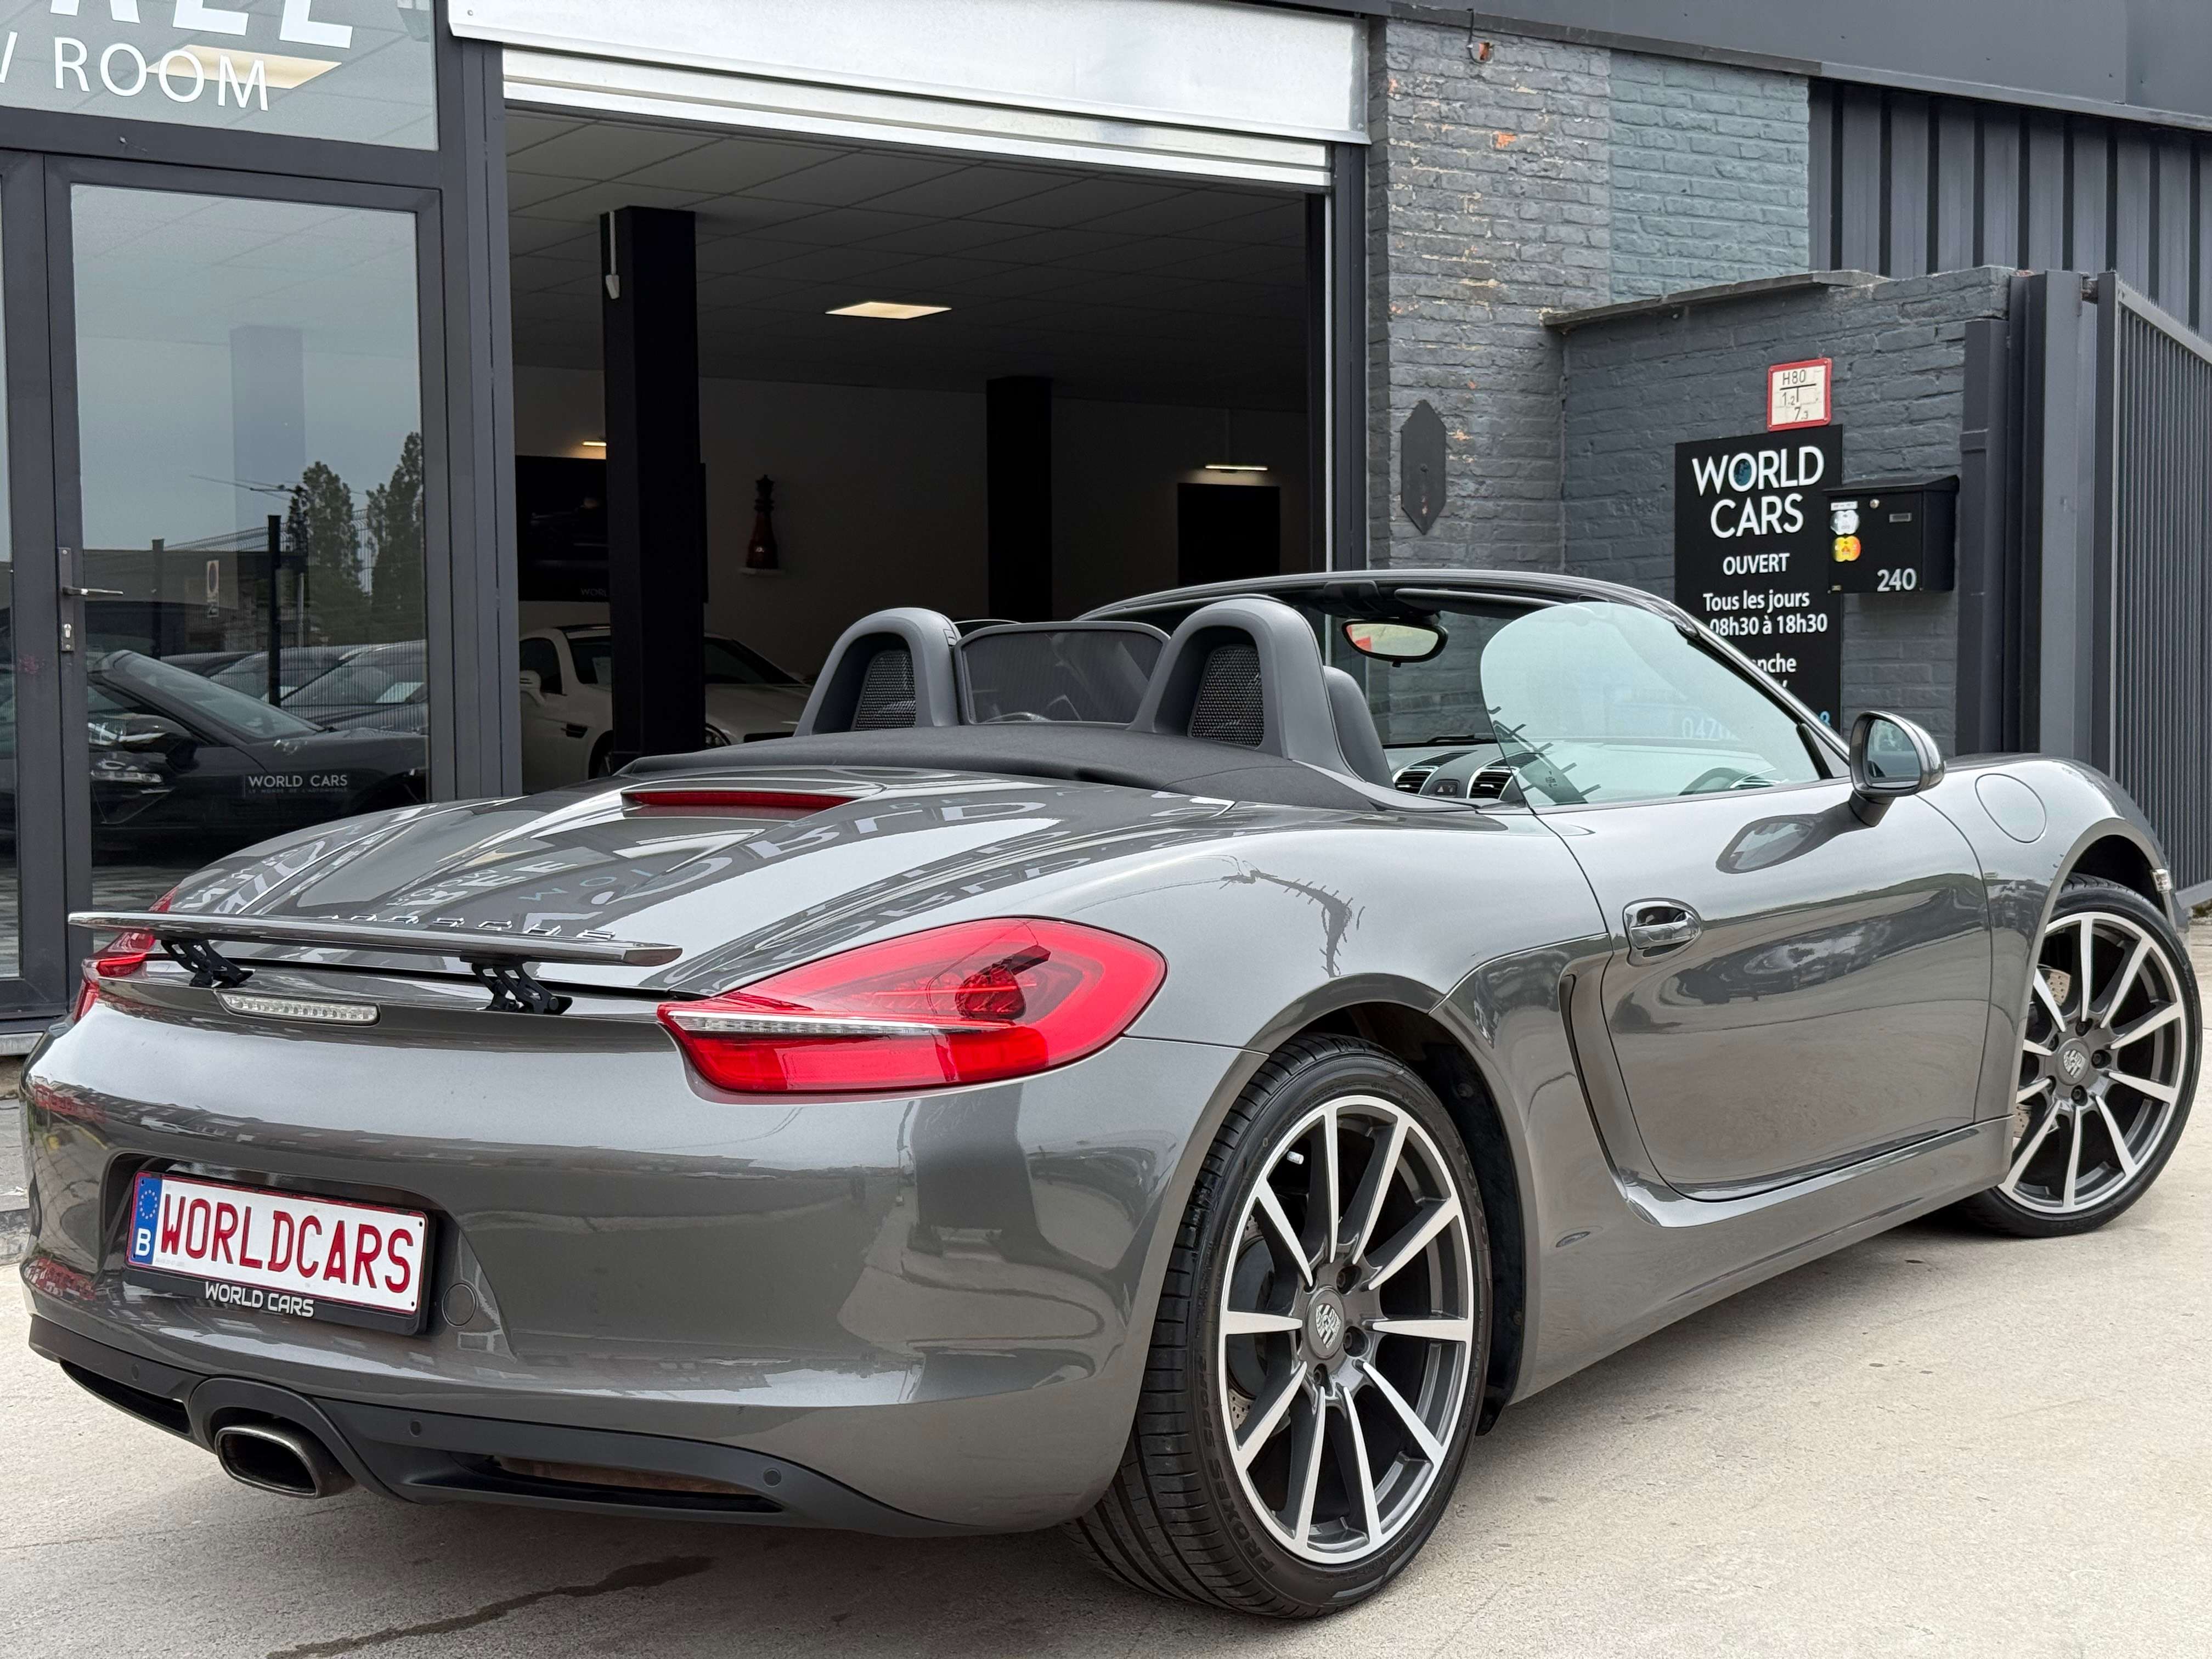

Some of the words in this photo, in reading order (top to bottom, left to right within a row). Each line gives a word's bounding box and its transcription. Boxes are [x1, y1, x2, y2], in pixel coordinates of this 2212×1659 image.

[54, 36, 269, 111] ROOM
[1782, 369, 1806, 385] H80
[1691, 446, 1825, 496] WORLD
[1710, 493, 1804, 539] CARS
[1723, 552, 1790, 575] OUVERT
[1877, 568, 1917, 592] 240
[580, 588, 609, 597] WORL
[1702, 592, 1740, 612] Tous
[1743, 590, 1765, 610] les
[1767, 589, 1810, 613] jours
[1709, 616, 1759, 636] 08h30
[1762, 614, 1773, 635] à
[1776, 613, 1828, 634] 18h30
[1752, 653, 1797, 673] nche
[248, 775, 303, 788] WORLD
[309, 774, 348, 787] CARS
[135, 1228, 151, 1256] B
[161, 1193, 414, 1294] WORLDCARS
[205, 1281, 264, 1308] WORLD
[267, 1293, 315, 1318] CARS
